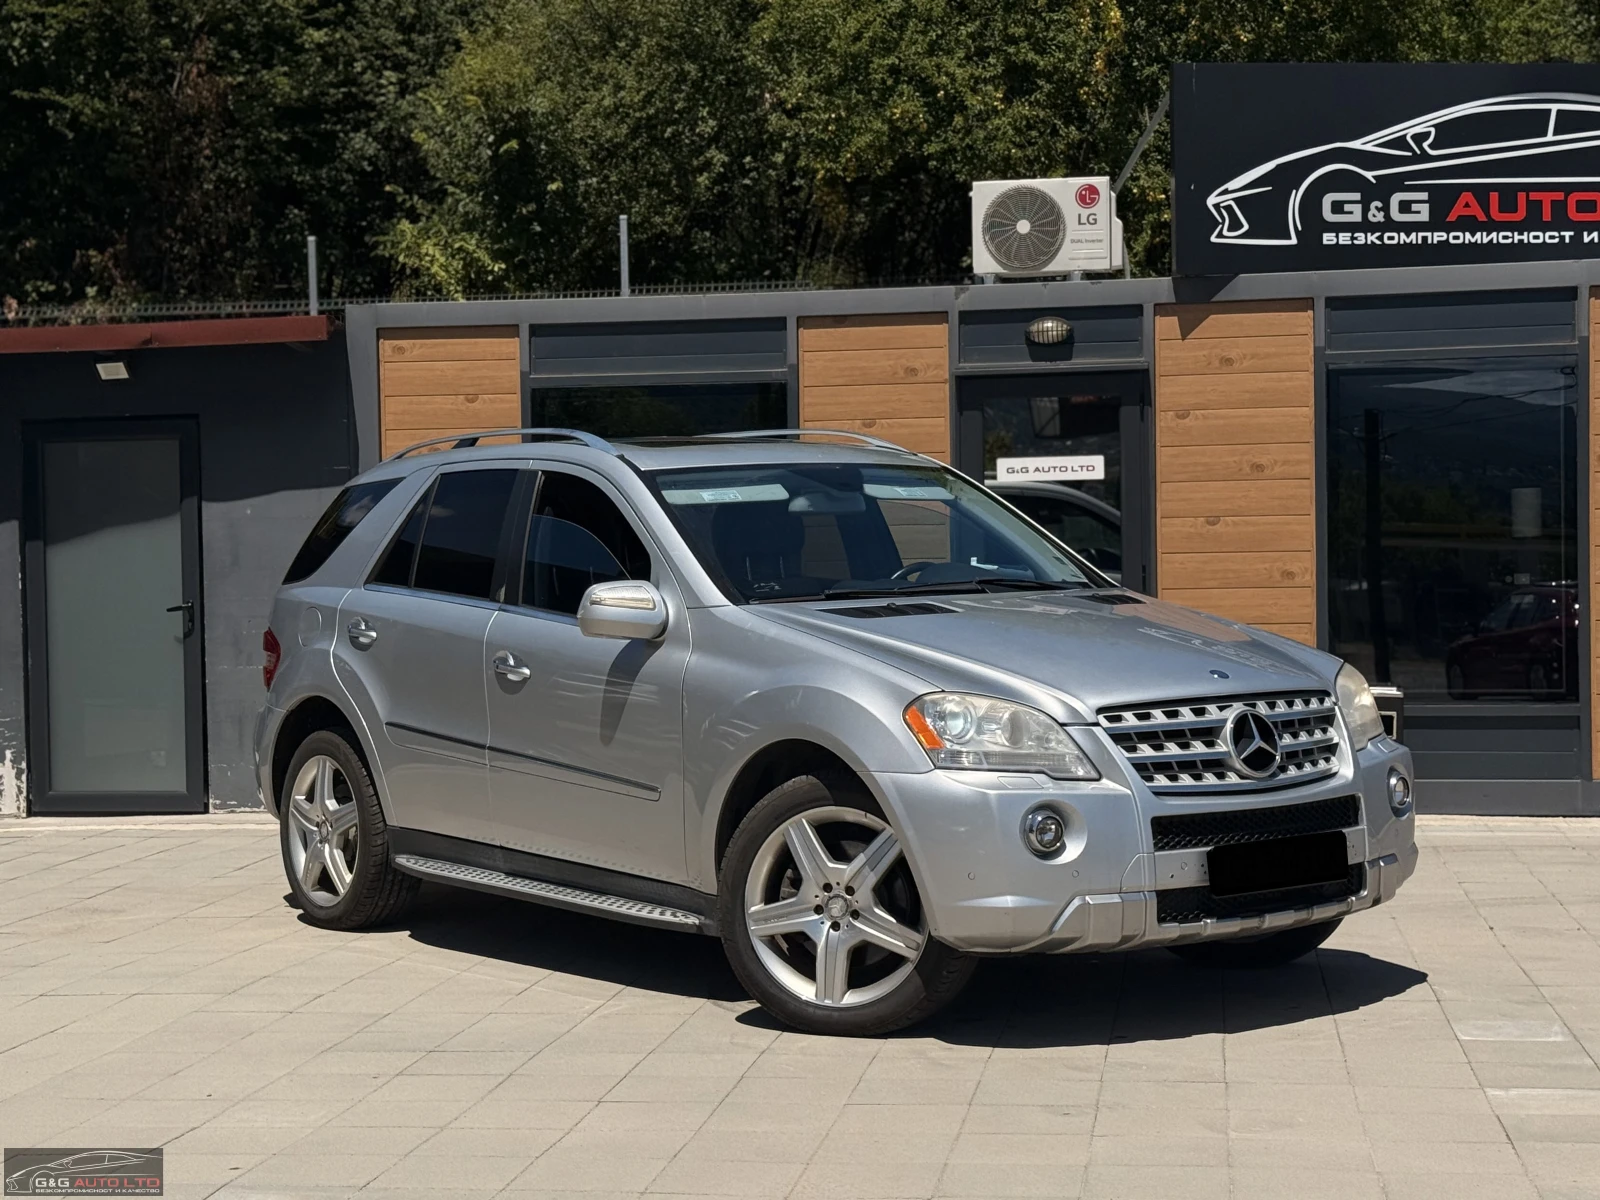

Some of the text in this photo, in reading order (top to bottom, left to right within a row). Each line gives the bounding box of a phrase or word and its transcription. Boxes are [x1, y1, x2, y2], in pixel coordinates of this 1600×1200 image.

[1322, 191, 1600, 223] G&G AUTO
[1077, 213, 1098, 226] LG
[1322, 231, 1599, 245] БЕЗКОМПРОМИСНОСТ И
[1006, 464, 1095, 474] G&G AUTO LTD
